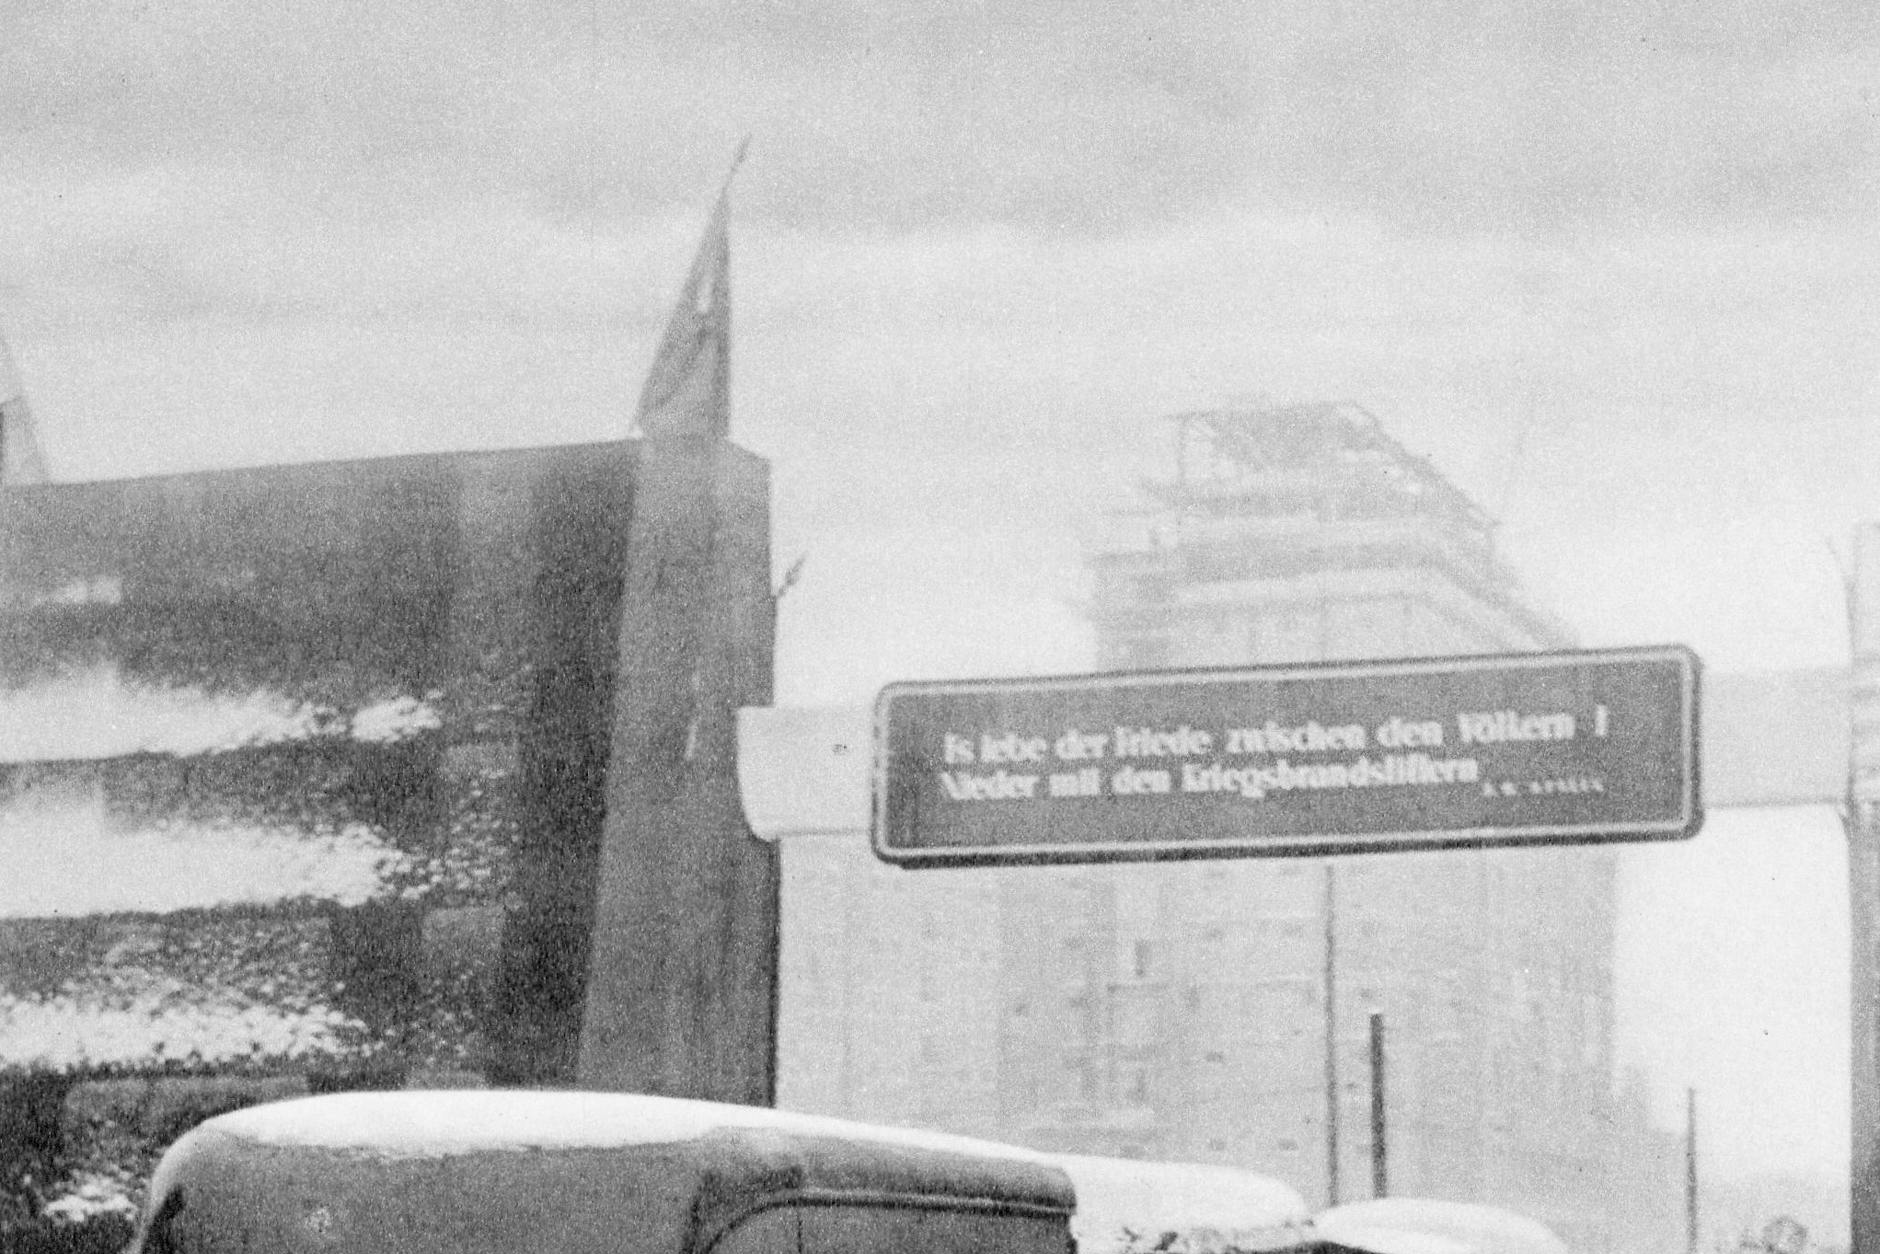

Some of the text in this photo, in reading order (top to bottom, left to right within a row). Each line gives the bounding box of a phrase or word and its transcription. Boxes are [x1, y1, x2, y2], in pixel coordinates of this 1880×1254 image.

[1055, 728, 1108, 760] der
[1376, 715, 1443, 747] den
[1112, 765, 1170, 795] den
